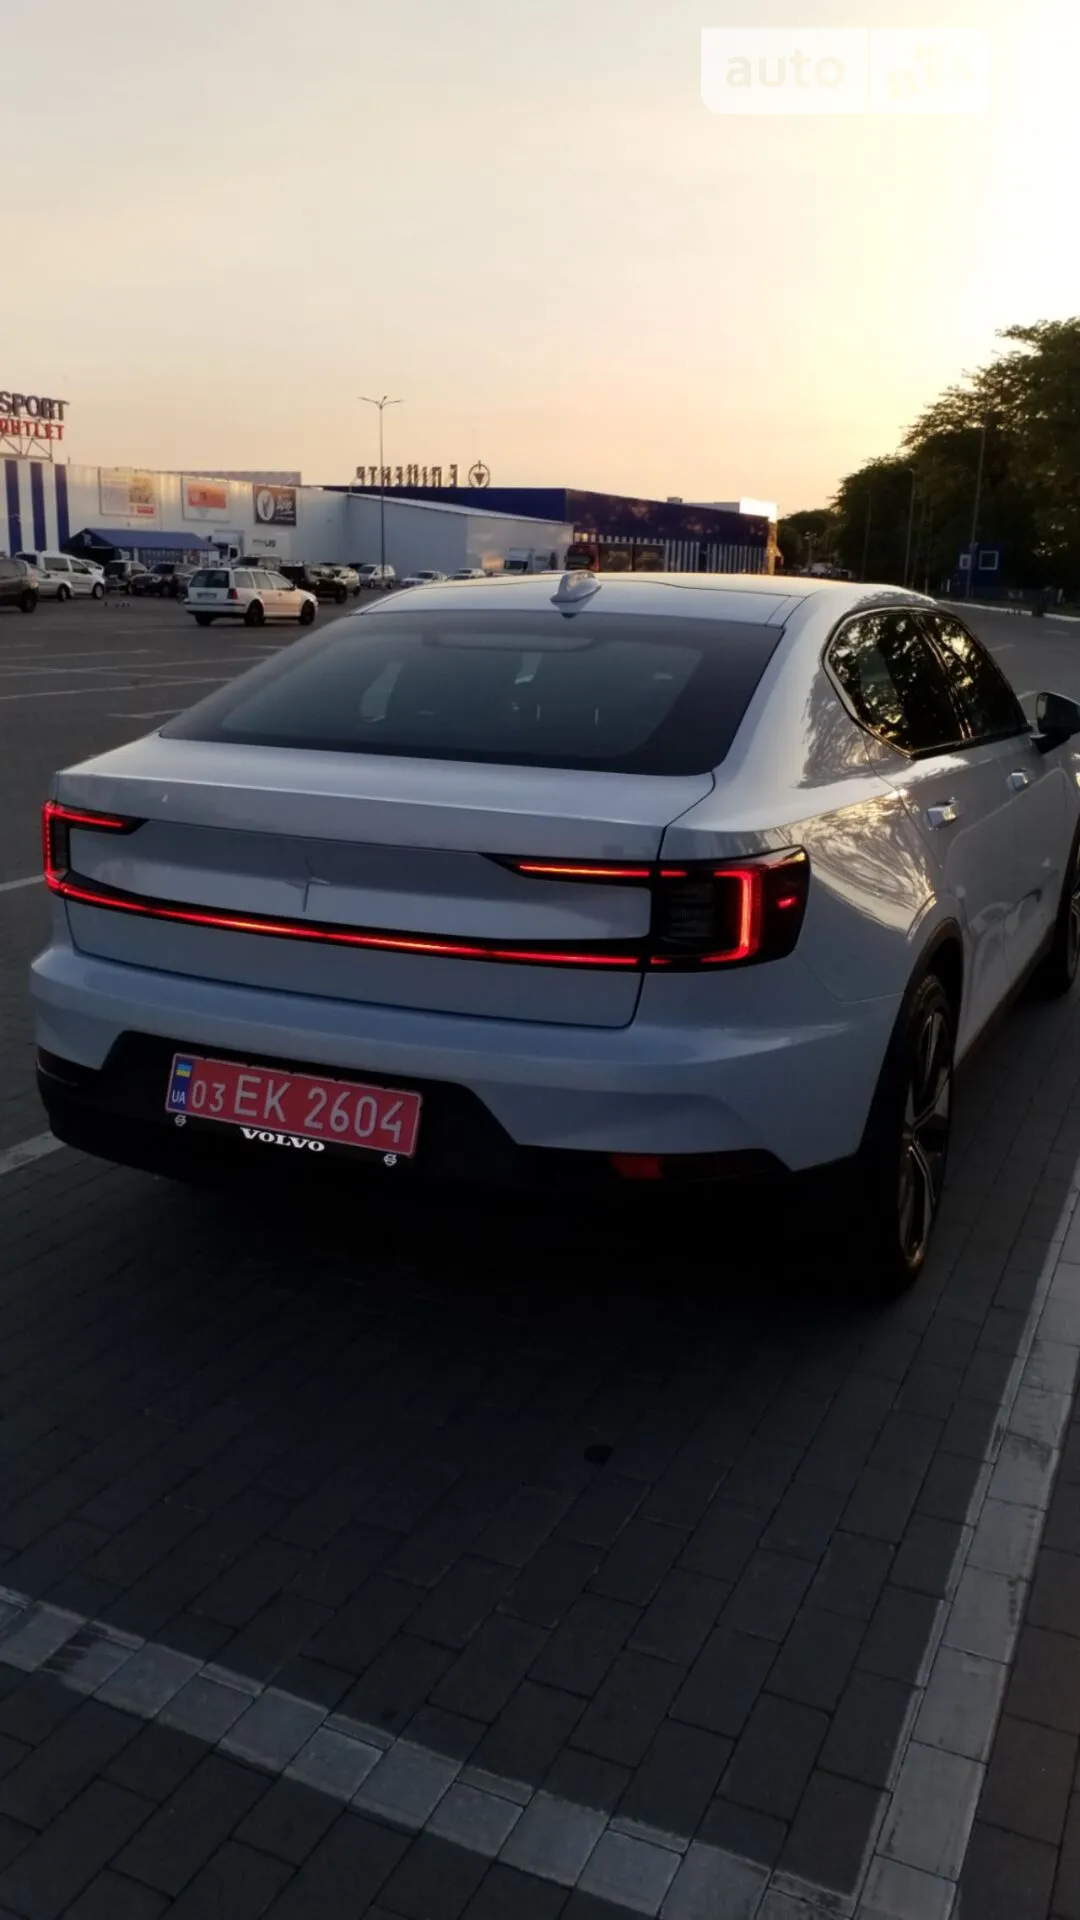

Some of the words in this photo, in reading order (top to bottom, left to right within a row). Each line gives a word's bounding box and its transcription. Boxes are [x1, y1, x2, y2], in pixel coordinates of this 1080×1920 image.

[0, 391, 69, 421] SPORT
[0, 418, 65, 441] OUTLET
[172, 1089, 186, 1105] UA
[191, 1080, 227, 1113] 03
[234, 1074, 291, 1123] EK
[304, 1087, 404, 1143] 2604
[240, 1127, 326, 1152] VOLVO
